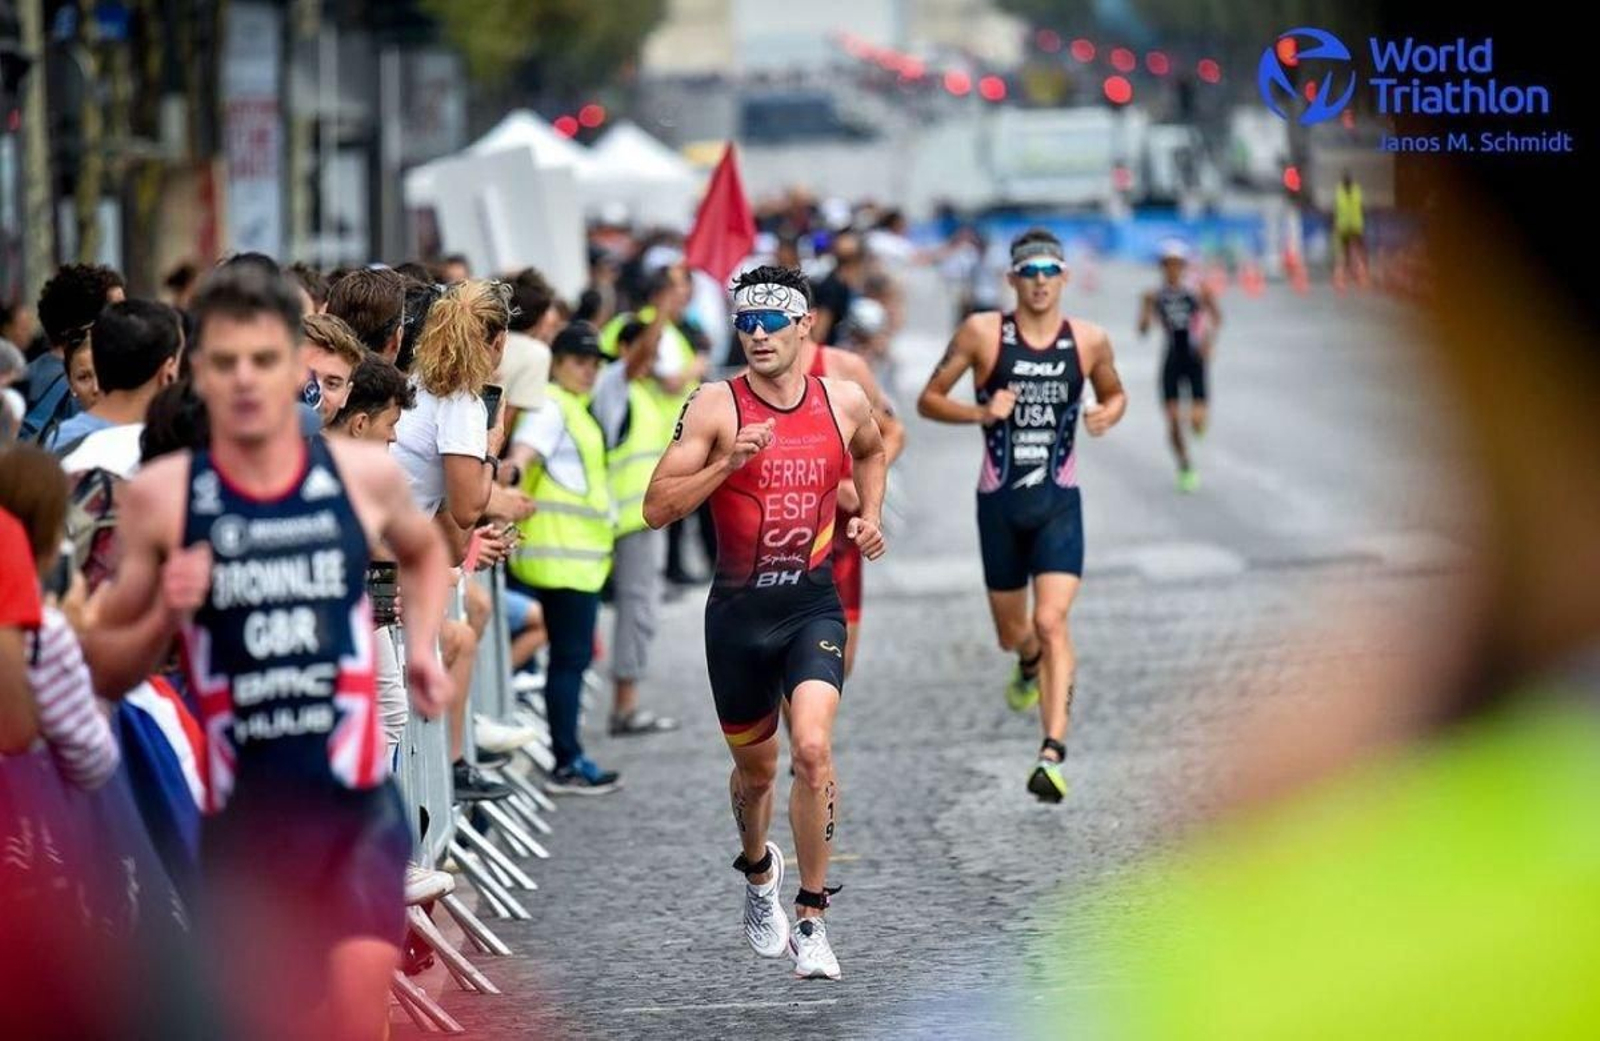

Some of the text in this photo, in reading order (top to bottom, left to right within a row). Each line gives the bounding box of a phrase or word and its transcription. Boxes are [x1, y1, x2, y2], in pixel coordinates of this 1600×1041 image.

[1014, 404, 1057, 428] USA
[758, 457, 827, 489] SERRAT
[764, 492, 817, 522] ESP
[756, 569, 802, 588] BH
[244, 606, 320, 660] GBR
